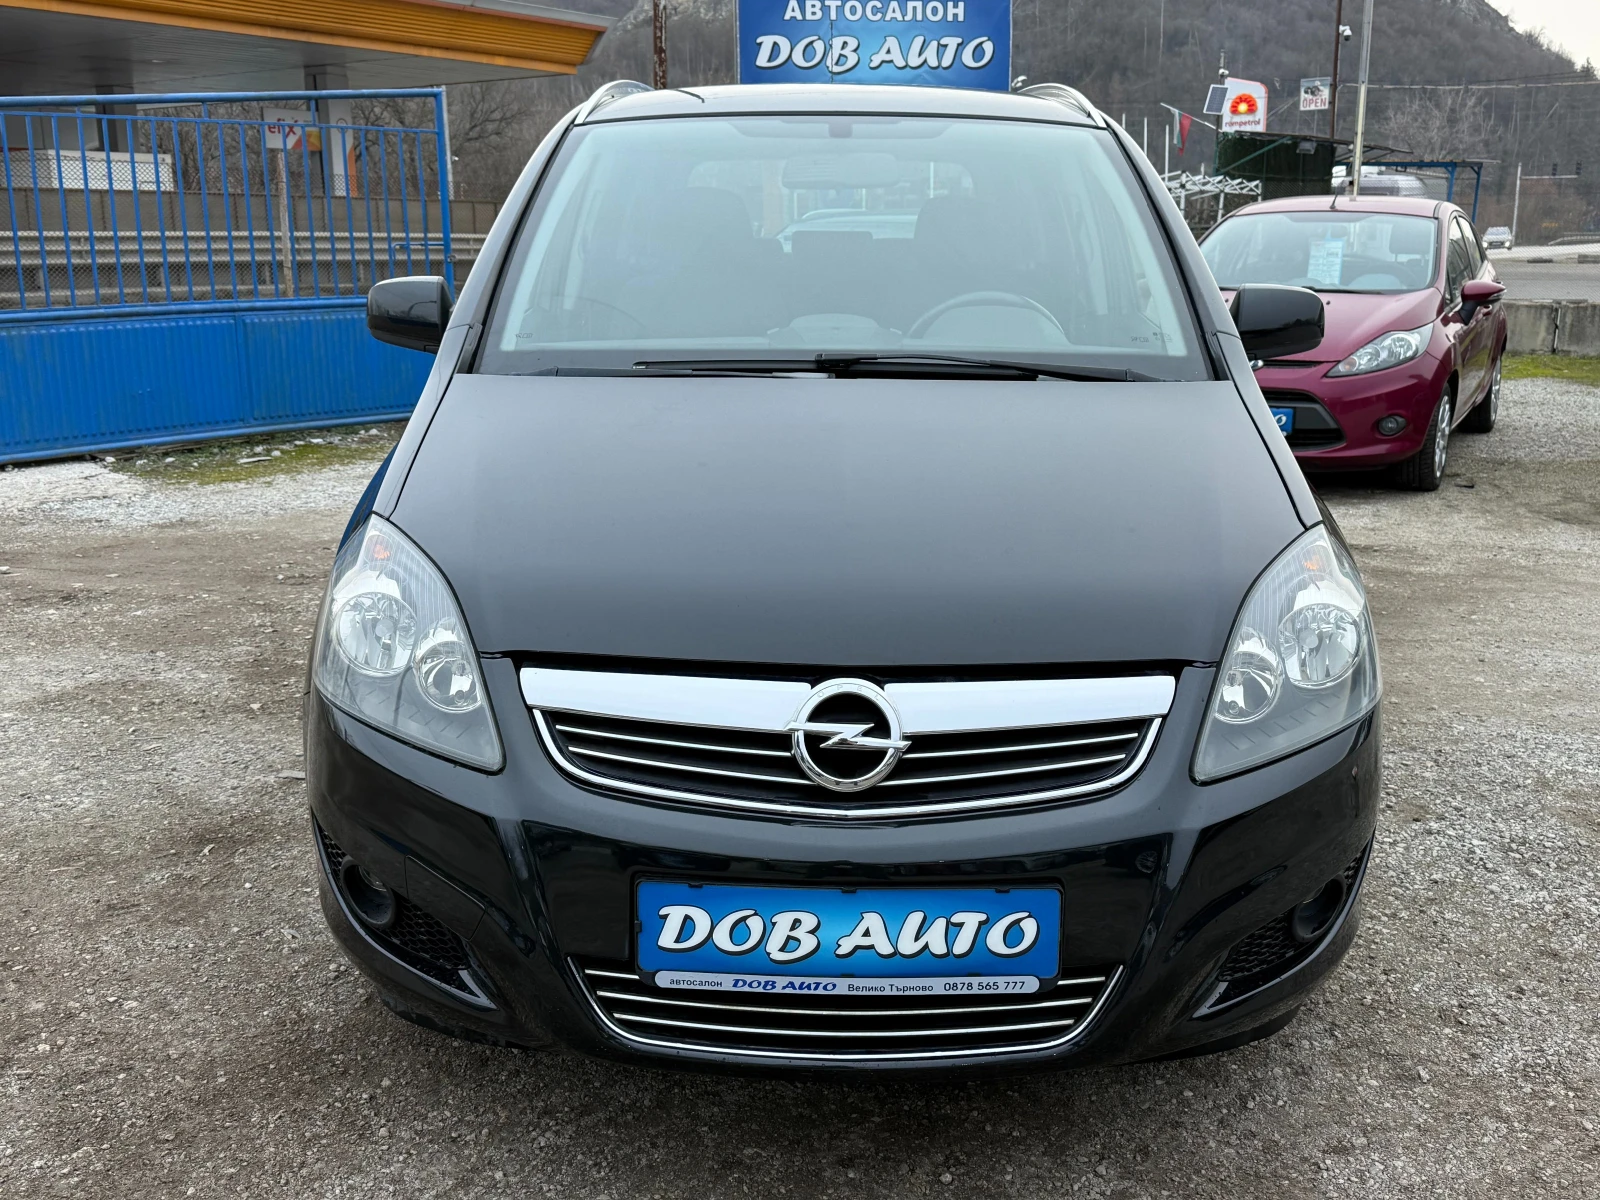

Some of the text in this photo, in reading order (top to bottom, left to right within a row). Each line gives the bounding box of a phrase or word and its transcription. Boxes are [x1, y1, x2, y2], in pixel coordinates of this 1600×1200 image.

[784, 1, 965, 22] АВТОСАЛОН
[755, 35, 994, 75] DOB AUTO
[1302, 97, 1327, 109] OPEN
[267, 118, 298, 138] efx
[1225, 118, 1261, 128] rompetrol
[817, 685, 880, 701] OPEL
[656, 905, 1040, 964] DOB AUTO
[669, 978, 1026, 993] автосалон DOB AUTO Велико Търново 0878 565 777
